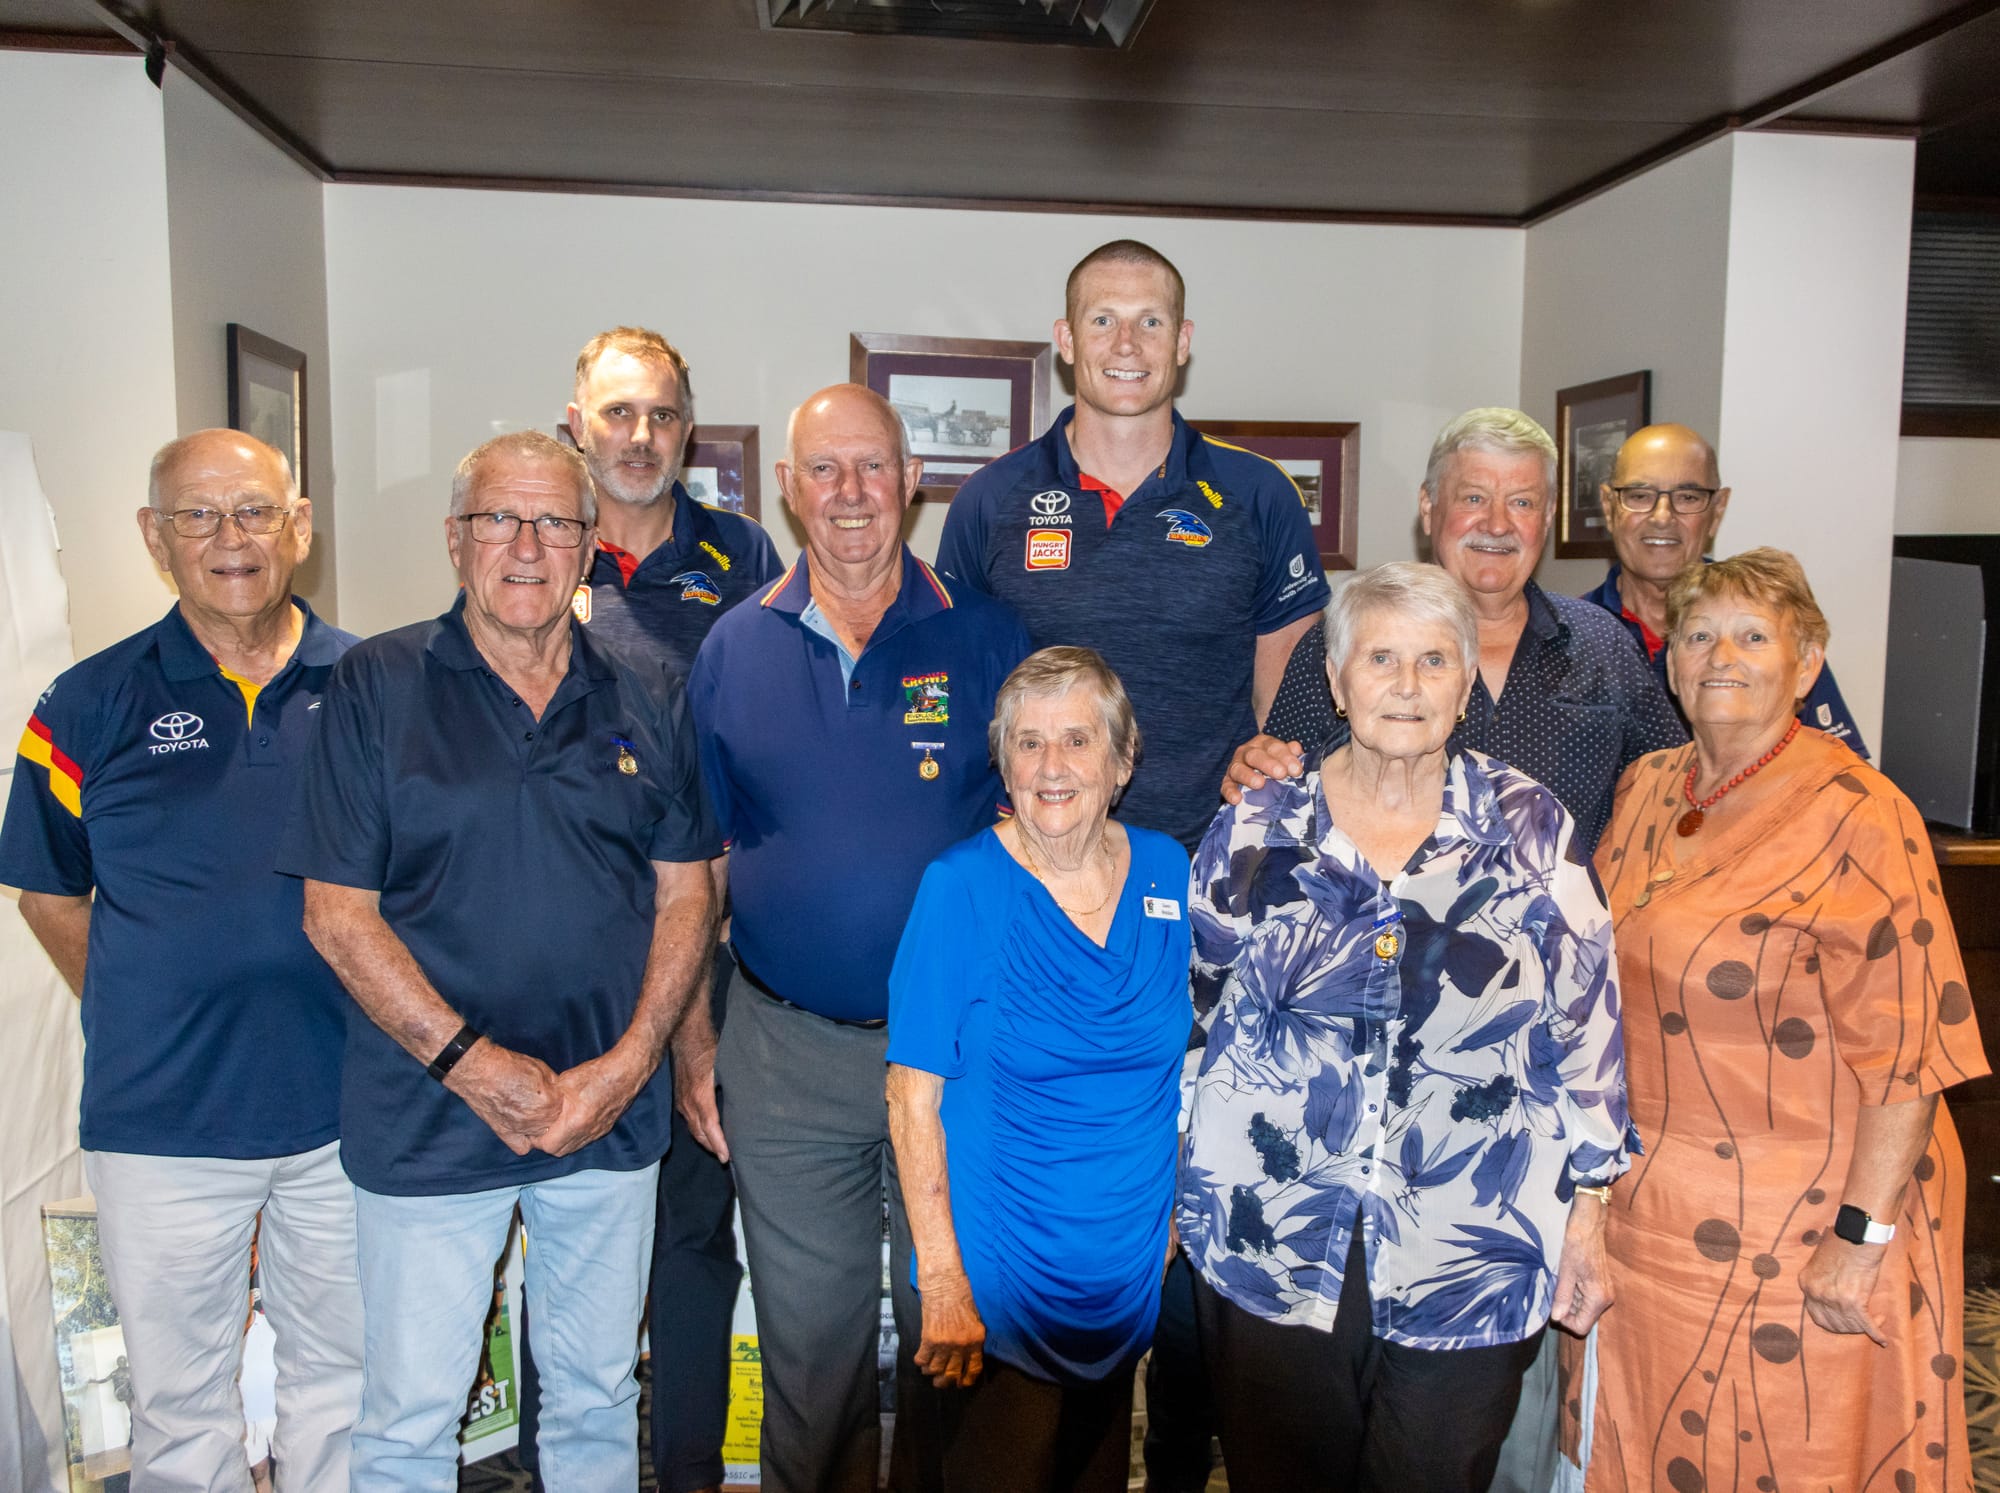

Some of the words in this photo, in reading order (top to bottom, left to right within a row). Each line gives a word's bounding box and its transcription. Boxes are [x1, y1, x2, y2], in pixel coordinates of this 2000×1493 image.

[1029, 514, 1073, 526] TOYOTA
[902, 671, 949, 688] CROWS
[148, 738, 210, 755] TOYOTA
